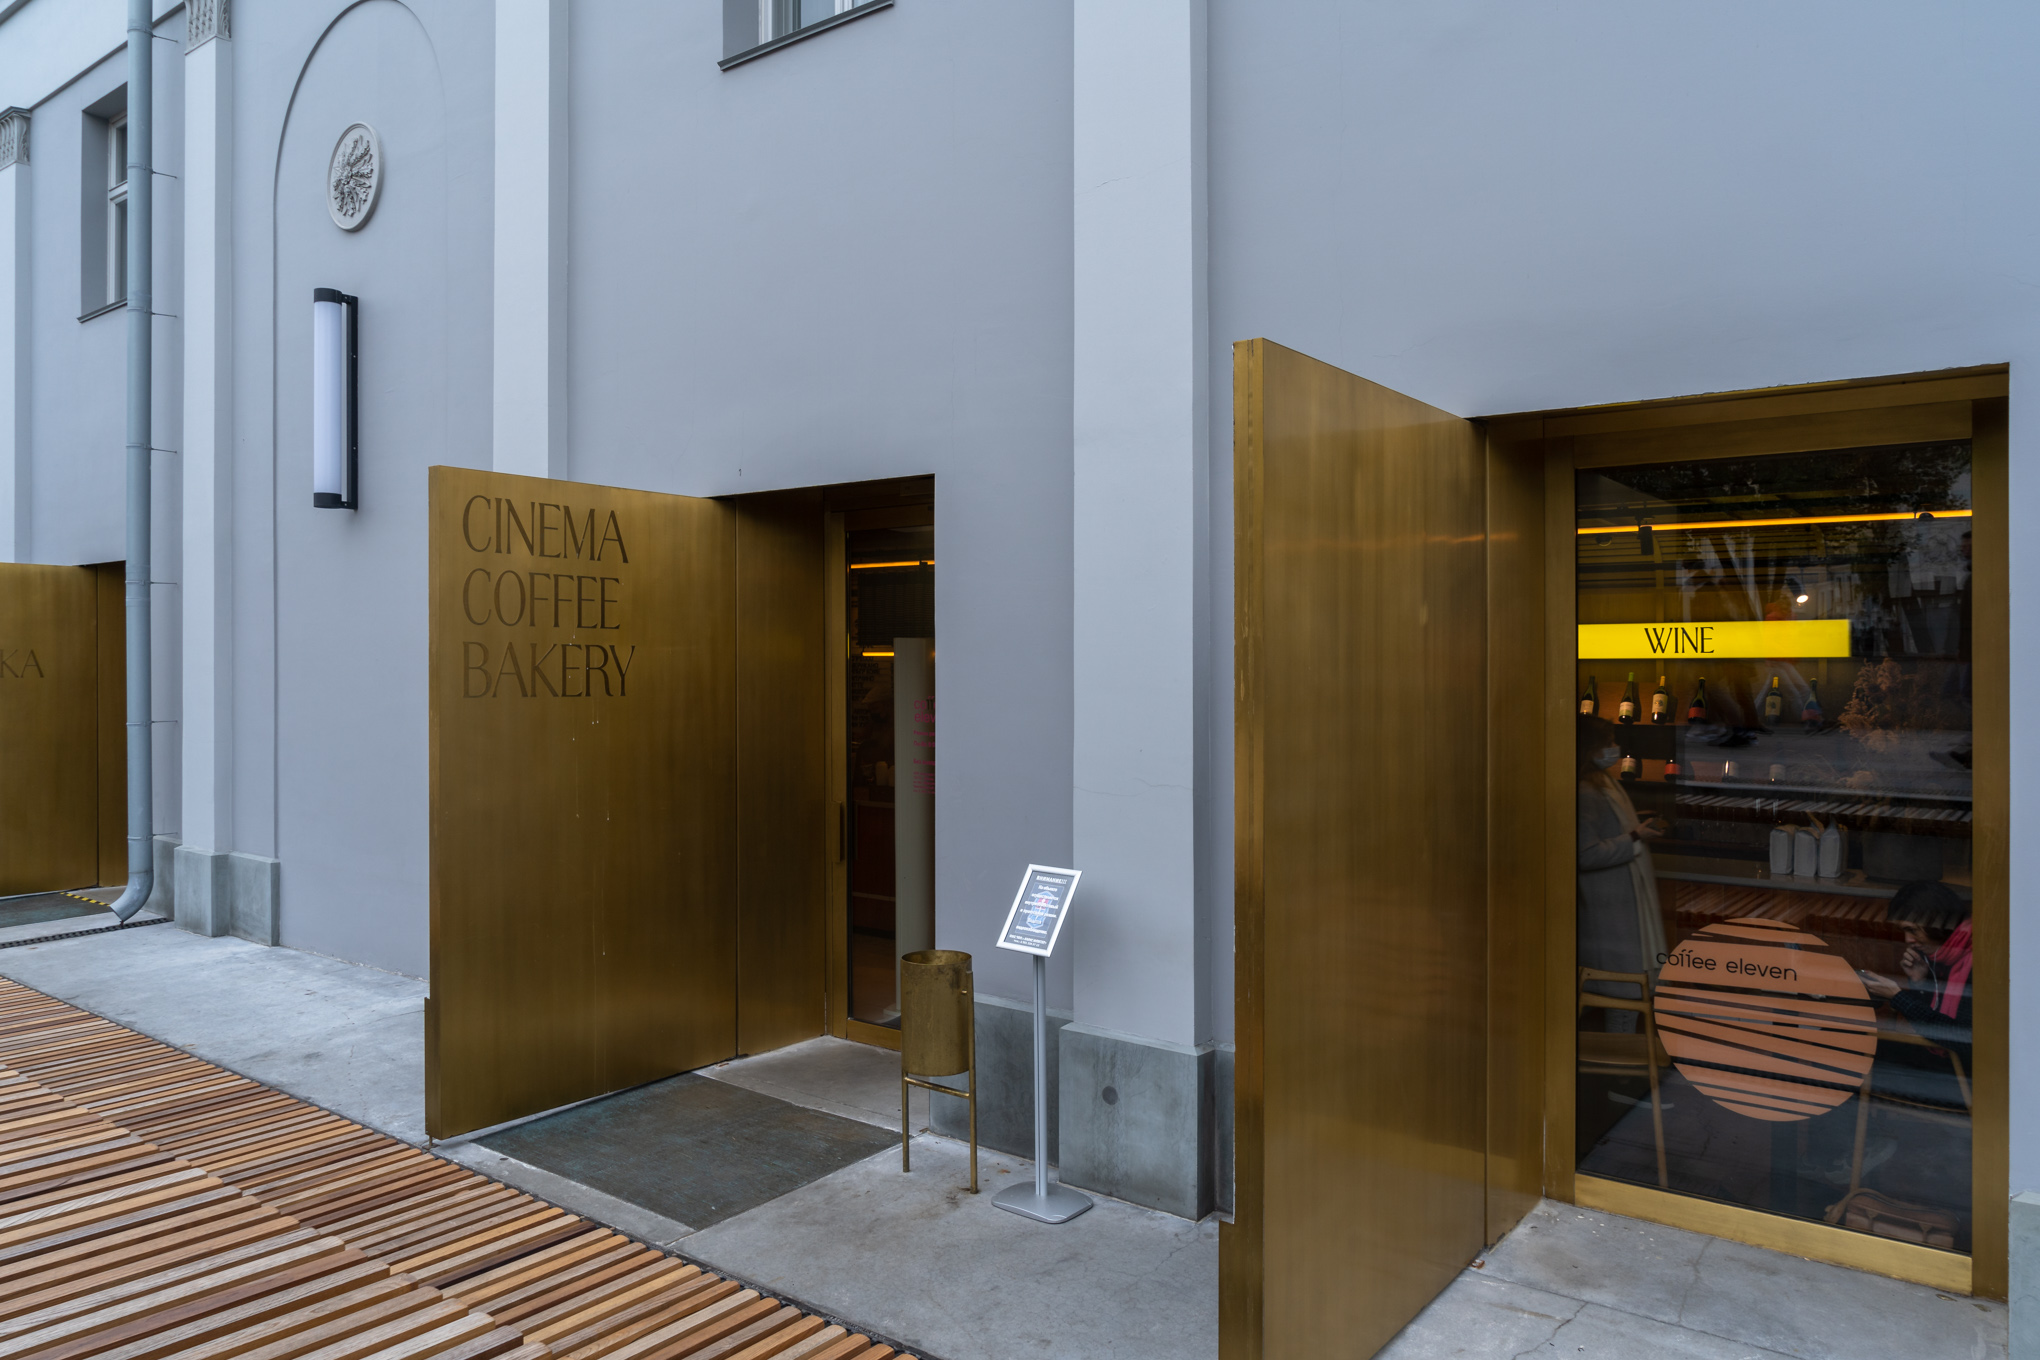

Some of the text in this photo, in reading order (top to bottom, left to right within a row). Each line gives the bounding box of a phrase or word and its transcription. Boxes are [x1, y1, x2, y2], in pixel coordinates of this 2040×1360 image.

[463, 494, 629, 564] CINEMA
[463, 568, 621, 630] COFFEE
[1643, 626, 1715, 655] WINE
[463, 641, 636, 698] BAKERY
[914, 711, 935, 723] elev
[1656, 949, 1798, 982] coffee eleven
